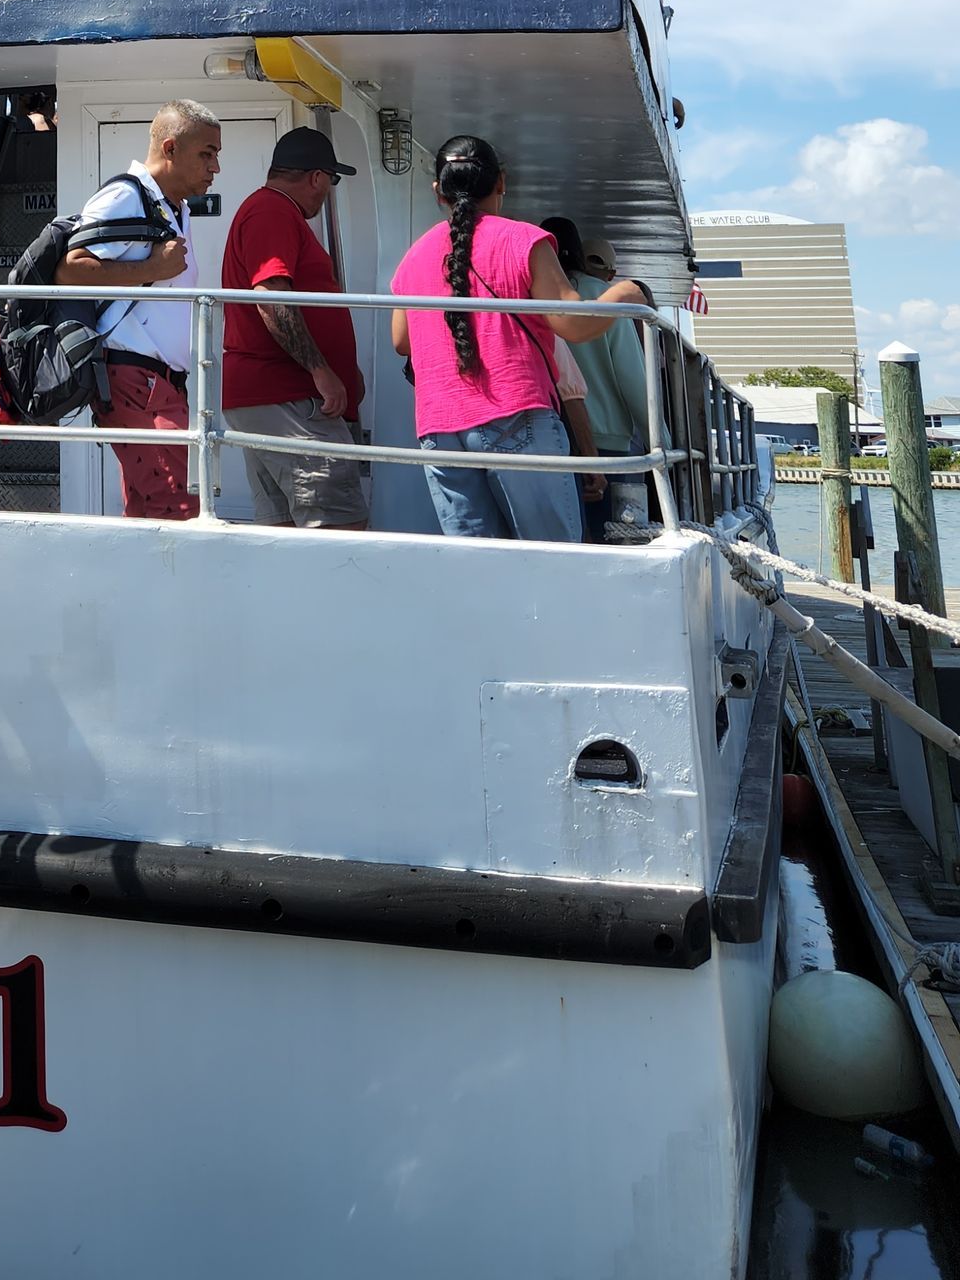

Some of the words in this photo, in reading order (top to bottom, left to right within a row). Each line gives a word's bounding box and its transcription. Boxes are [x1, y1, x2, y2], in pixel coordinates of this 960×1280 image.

[688, 216, 705, 225] THE
[709, 215, 742, 225] WATER
[745, 215, 770, 224] CLUB
